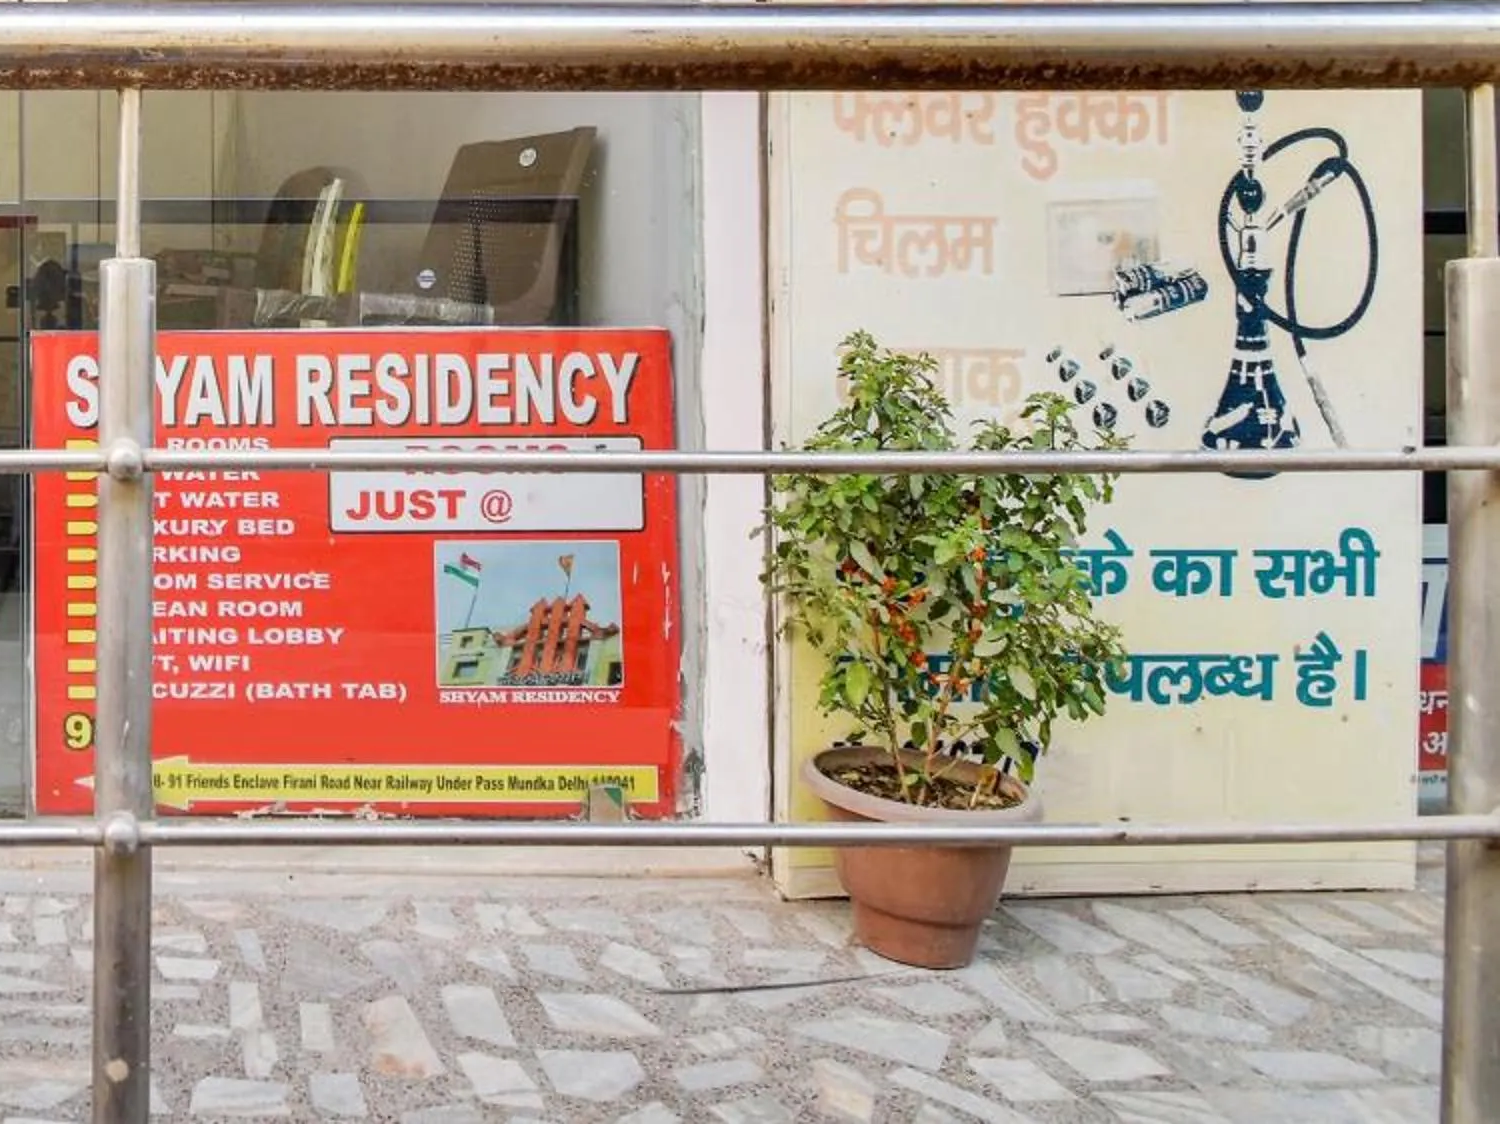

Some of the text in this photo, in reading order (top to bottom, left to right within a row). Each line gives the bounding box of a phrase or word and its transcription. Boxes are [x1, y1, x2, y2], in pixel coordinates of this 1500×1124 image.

[834, 188, 998, 277] चिलम
[65, 352, 642, 429] SYAM RESIDENCY
[167, 437, 269, 451] ROOMS
[180, 491, 281, 508] WATER
[346, 489, 513, 523] JUST @
[153, 519, 296, 536] XURY BED
[153, 546, 242, 563] RKING
[1150, 548, 1237, 597] का
[1254, 528, 1381, 598] सभी
[154, 572, 331, 590] OM SERVICE
[153, 600, 303, 617] EAN ROOM
[153, 627, 346, 645] ITING LOBBY
[188, 655, 251, 672] WIFI
[1060, 652, 1279, 705] पलब्ध
[152, 682, 408, 703] CUZZI (BATH TAB)
[439, 690, 622, 704] SHYAM RESIDENCY
[168, 774, 182, 790] 91
[186, 774, 231, 790] Friends
[233, 774, 280, 790] Enclave
[282, 774, 317, 790] Firani
[321, 774, 351, 790] Road
[353, 774, 382, 790] Near
[385, 774, 433, 794] Railway
[437, 775, 472, 791] Under
[475, 775, 505, 791] Pass
[508, 775, 555, 791] Mundka
